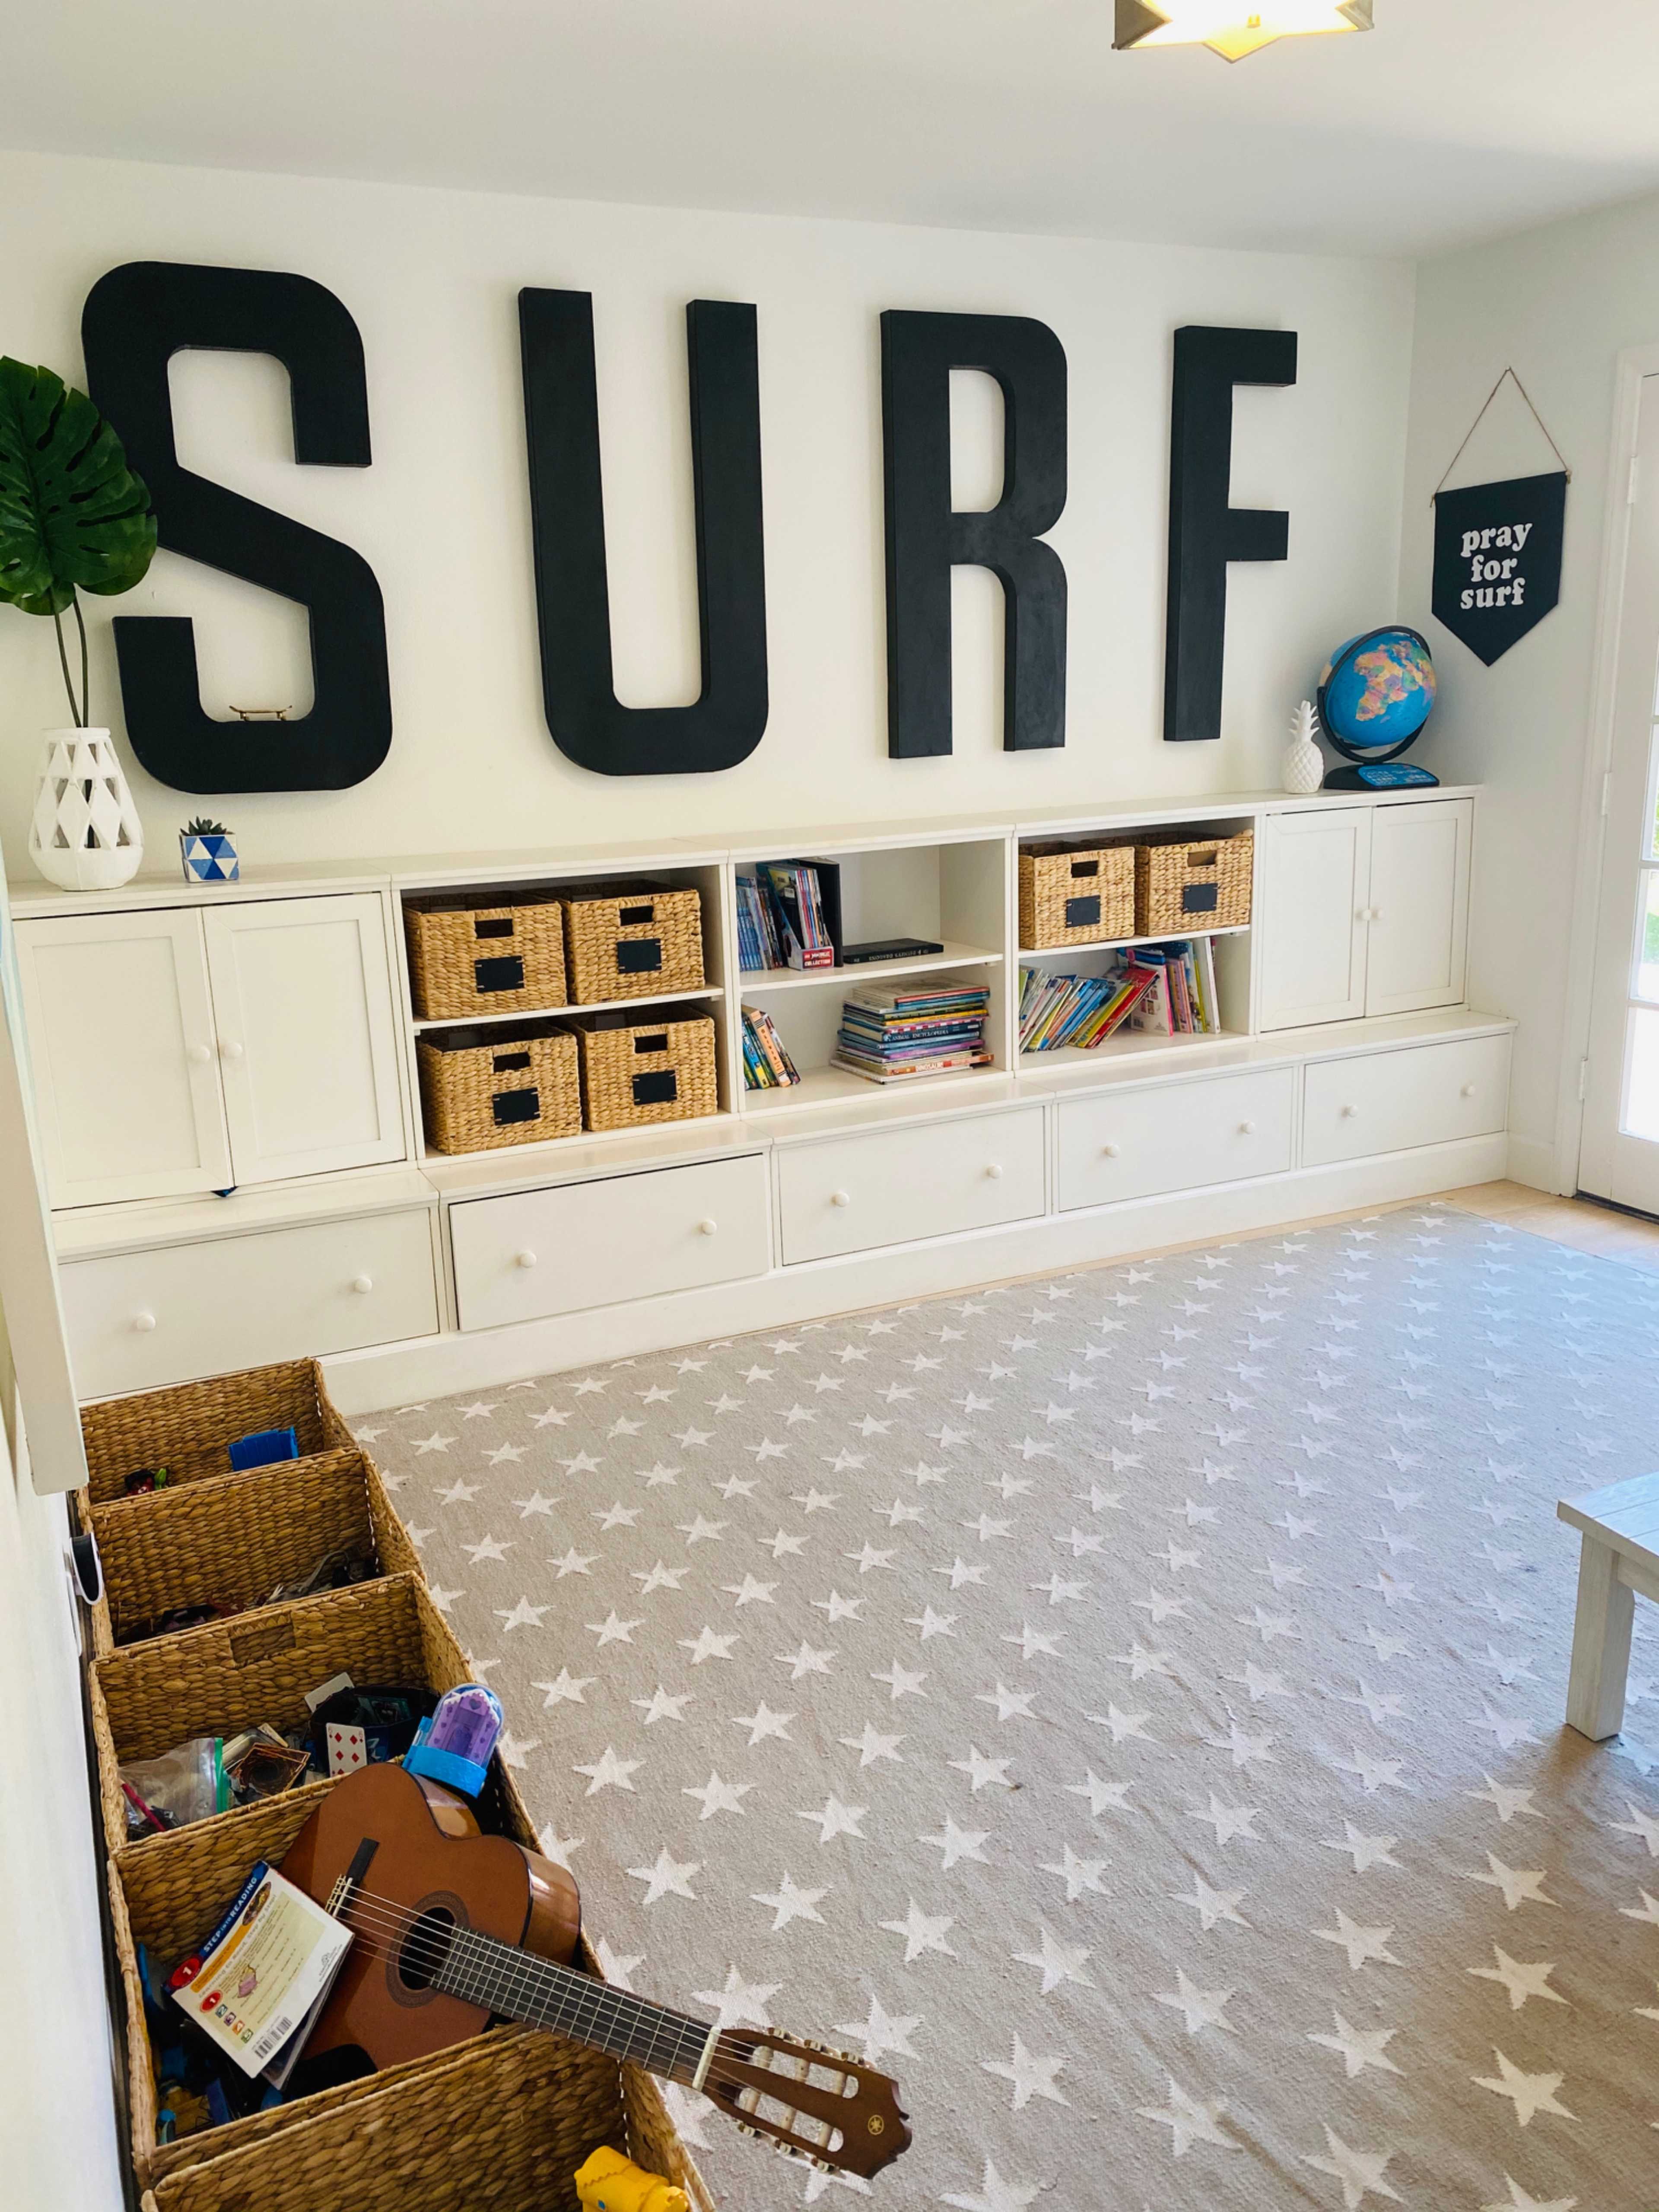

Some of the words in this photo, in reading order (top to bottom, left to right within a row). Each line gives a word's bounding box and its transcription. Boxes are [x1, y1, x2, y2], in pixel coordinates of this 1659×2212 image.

[81, 260, 1297, 795] SURF
[1460, 523, 1533, 557] pray
[1471, 554, 1518, 582] for
[1460, 577, 1526, 609] surf
[203, 1930, 221, 1952] STEP
[230, 1877, 257, 1917] READING
[183, 1967, 192, 1976] 1
